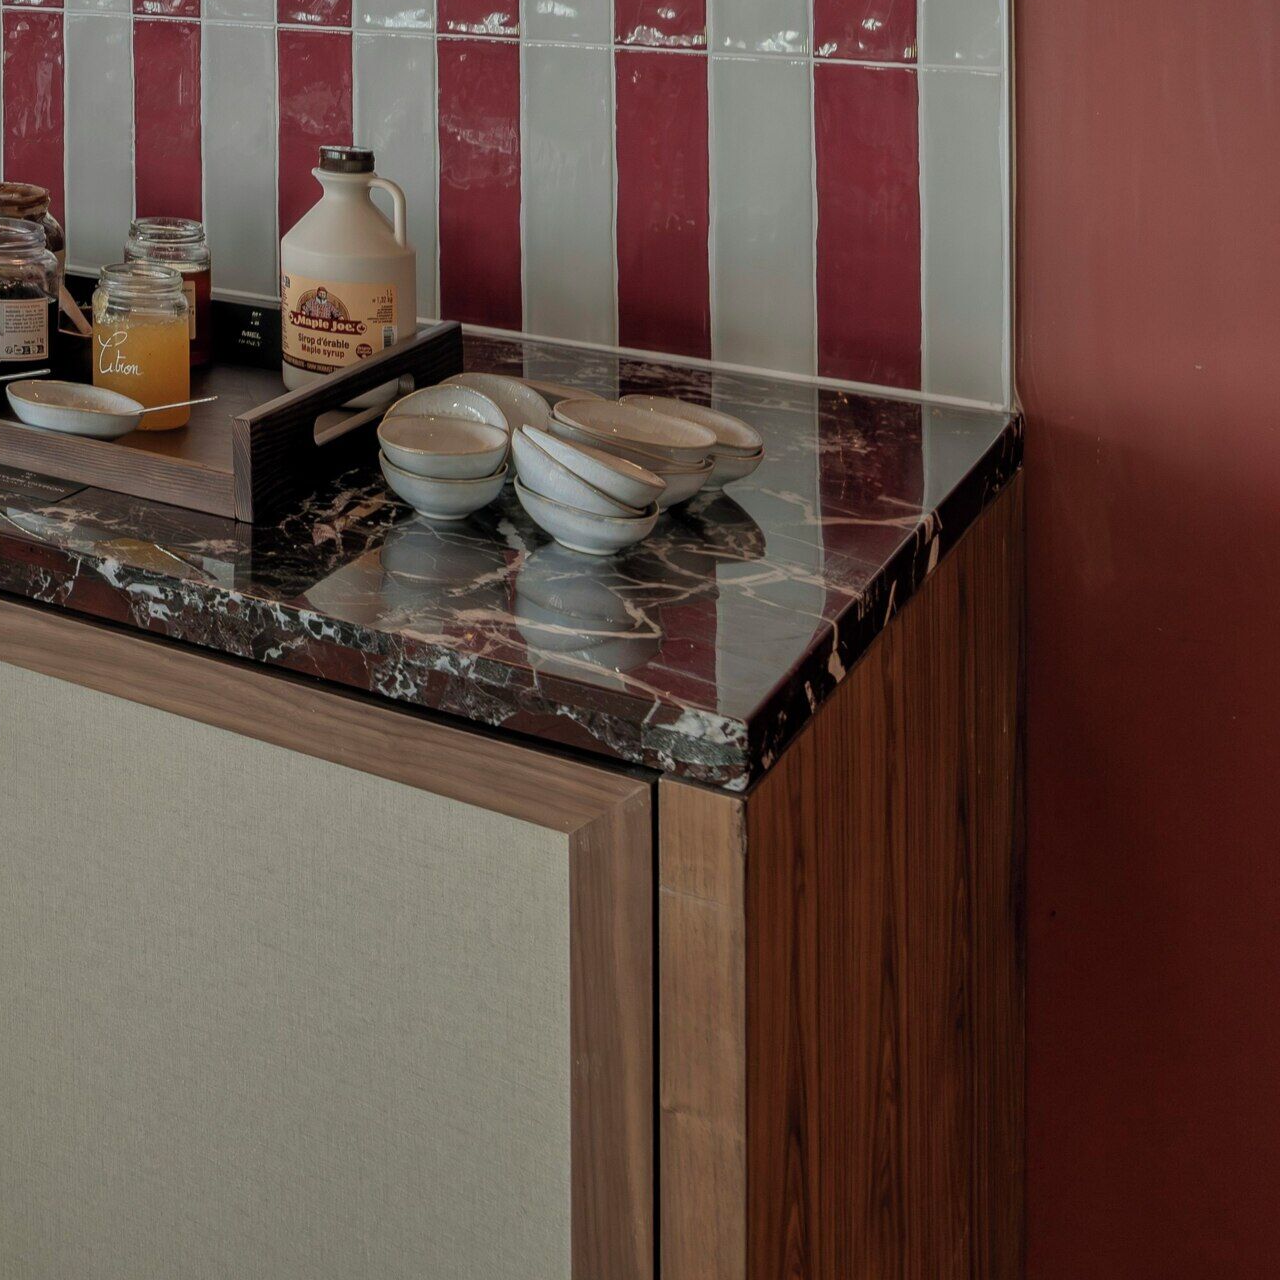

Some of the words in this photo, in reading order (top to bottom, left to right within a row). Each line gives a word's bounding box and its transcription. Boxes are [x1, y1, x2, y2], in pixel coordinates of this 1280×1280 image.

[294, 313, 330, 329] Maple
[330, 320, 353, 332] Joe
[241, 329, 262, 339] MIEL
[298, 332, 316, 345] Sirop
[316, 336, 350, 349] d'érable
[98, 331, 143, 376] Citron
[301, 343, 322, 355] Maple
[323, 348, 345, 360] syrup
